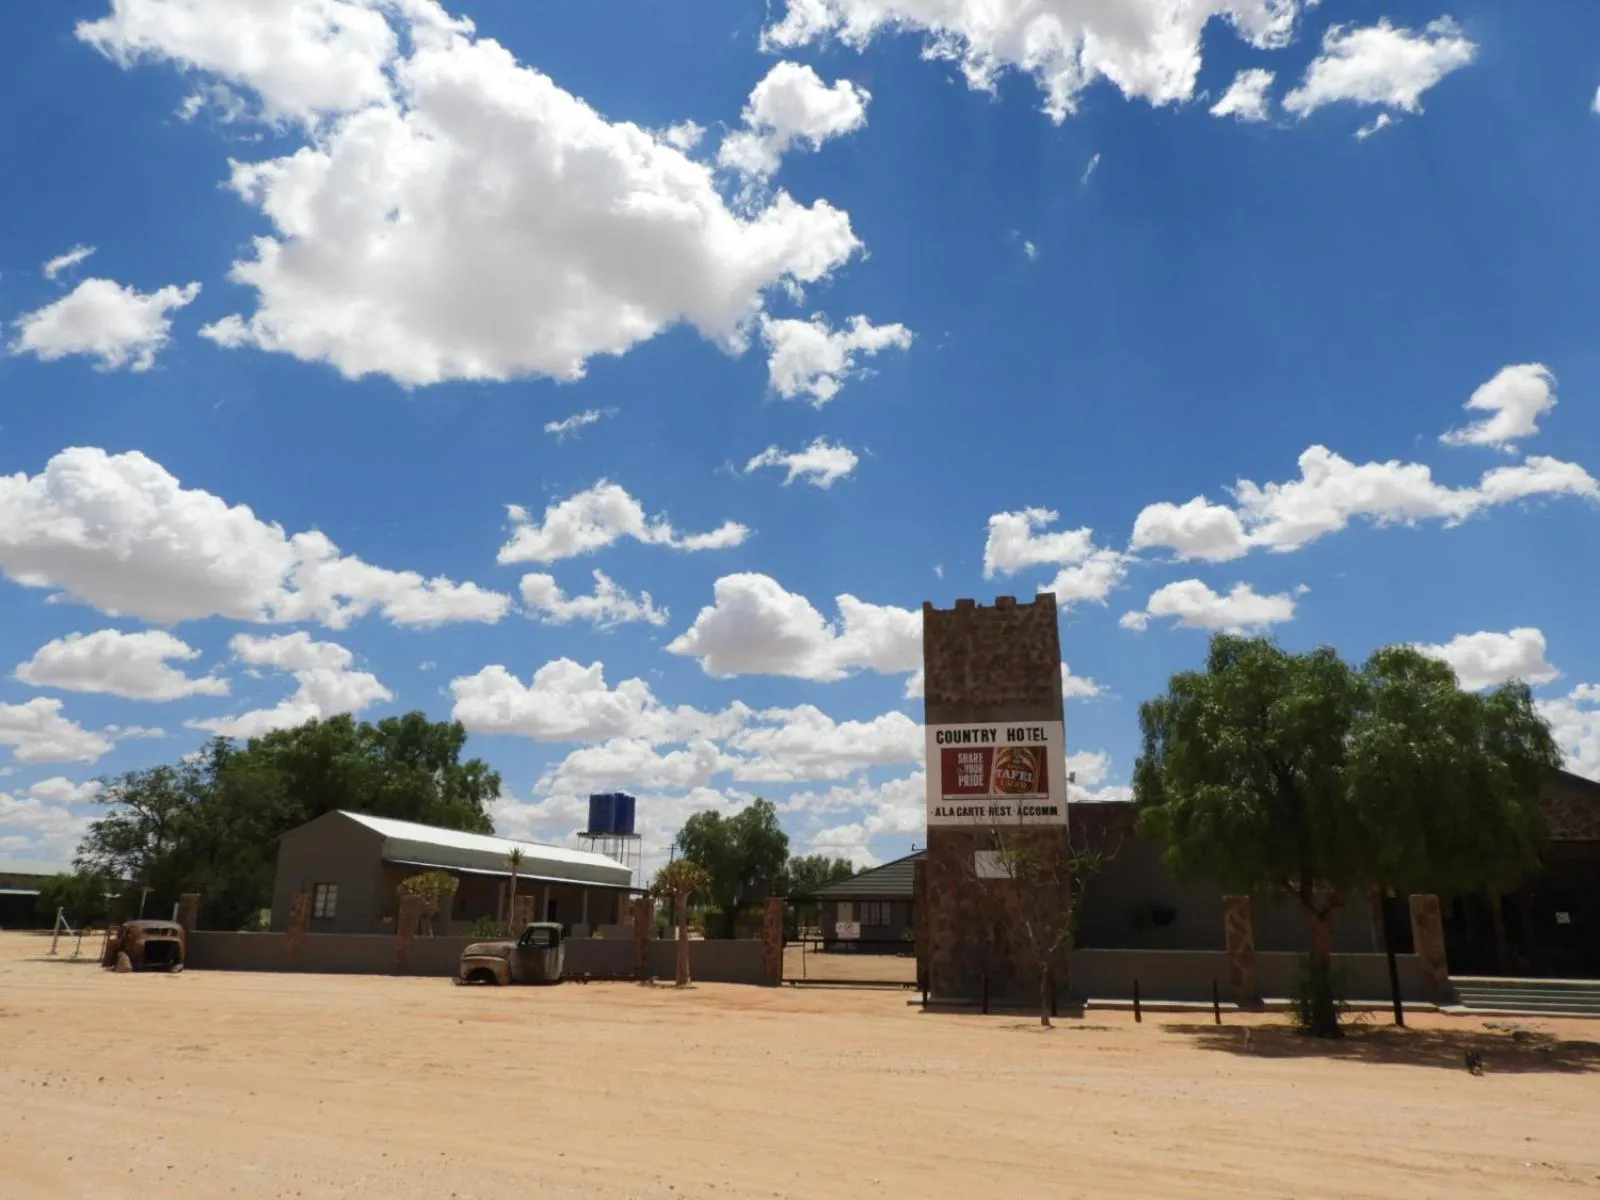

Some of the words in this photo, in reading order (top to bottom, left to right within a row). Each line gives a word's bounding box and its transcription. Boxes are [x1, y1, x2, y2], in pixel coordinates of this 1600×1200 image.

[936, 730, 997, 744] COUNTRY
[1007, 727, 1048, 742] HOTEL
[958, 752, 983, 764] SHARE
[964, 763, 984, 775] YOUR
[958, 774, 985, 787] PRIDE
[956, 806, 985, 817] CARTE
